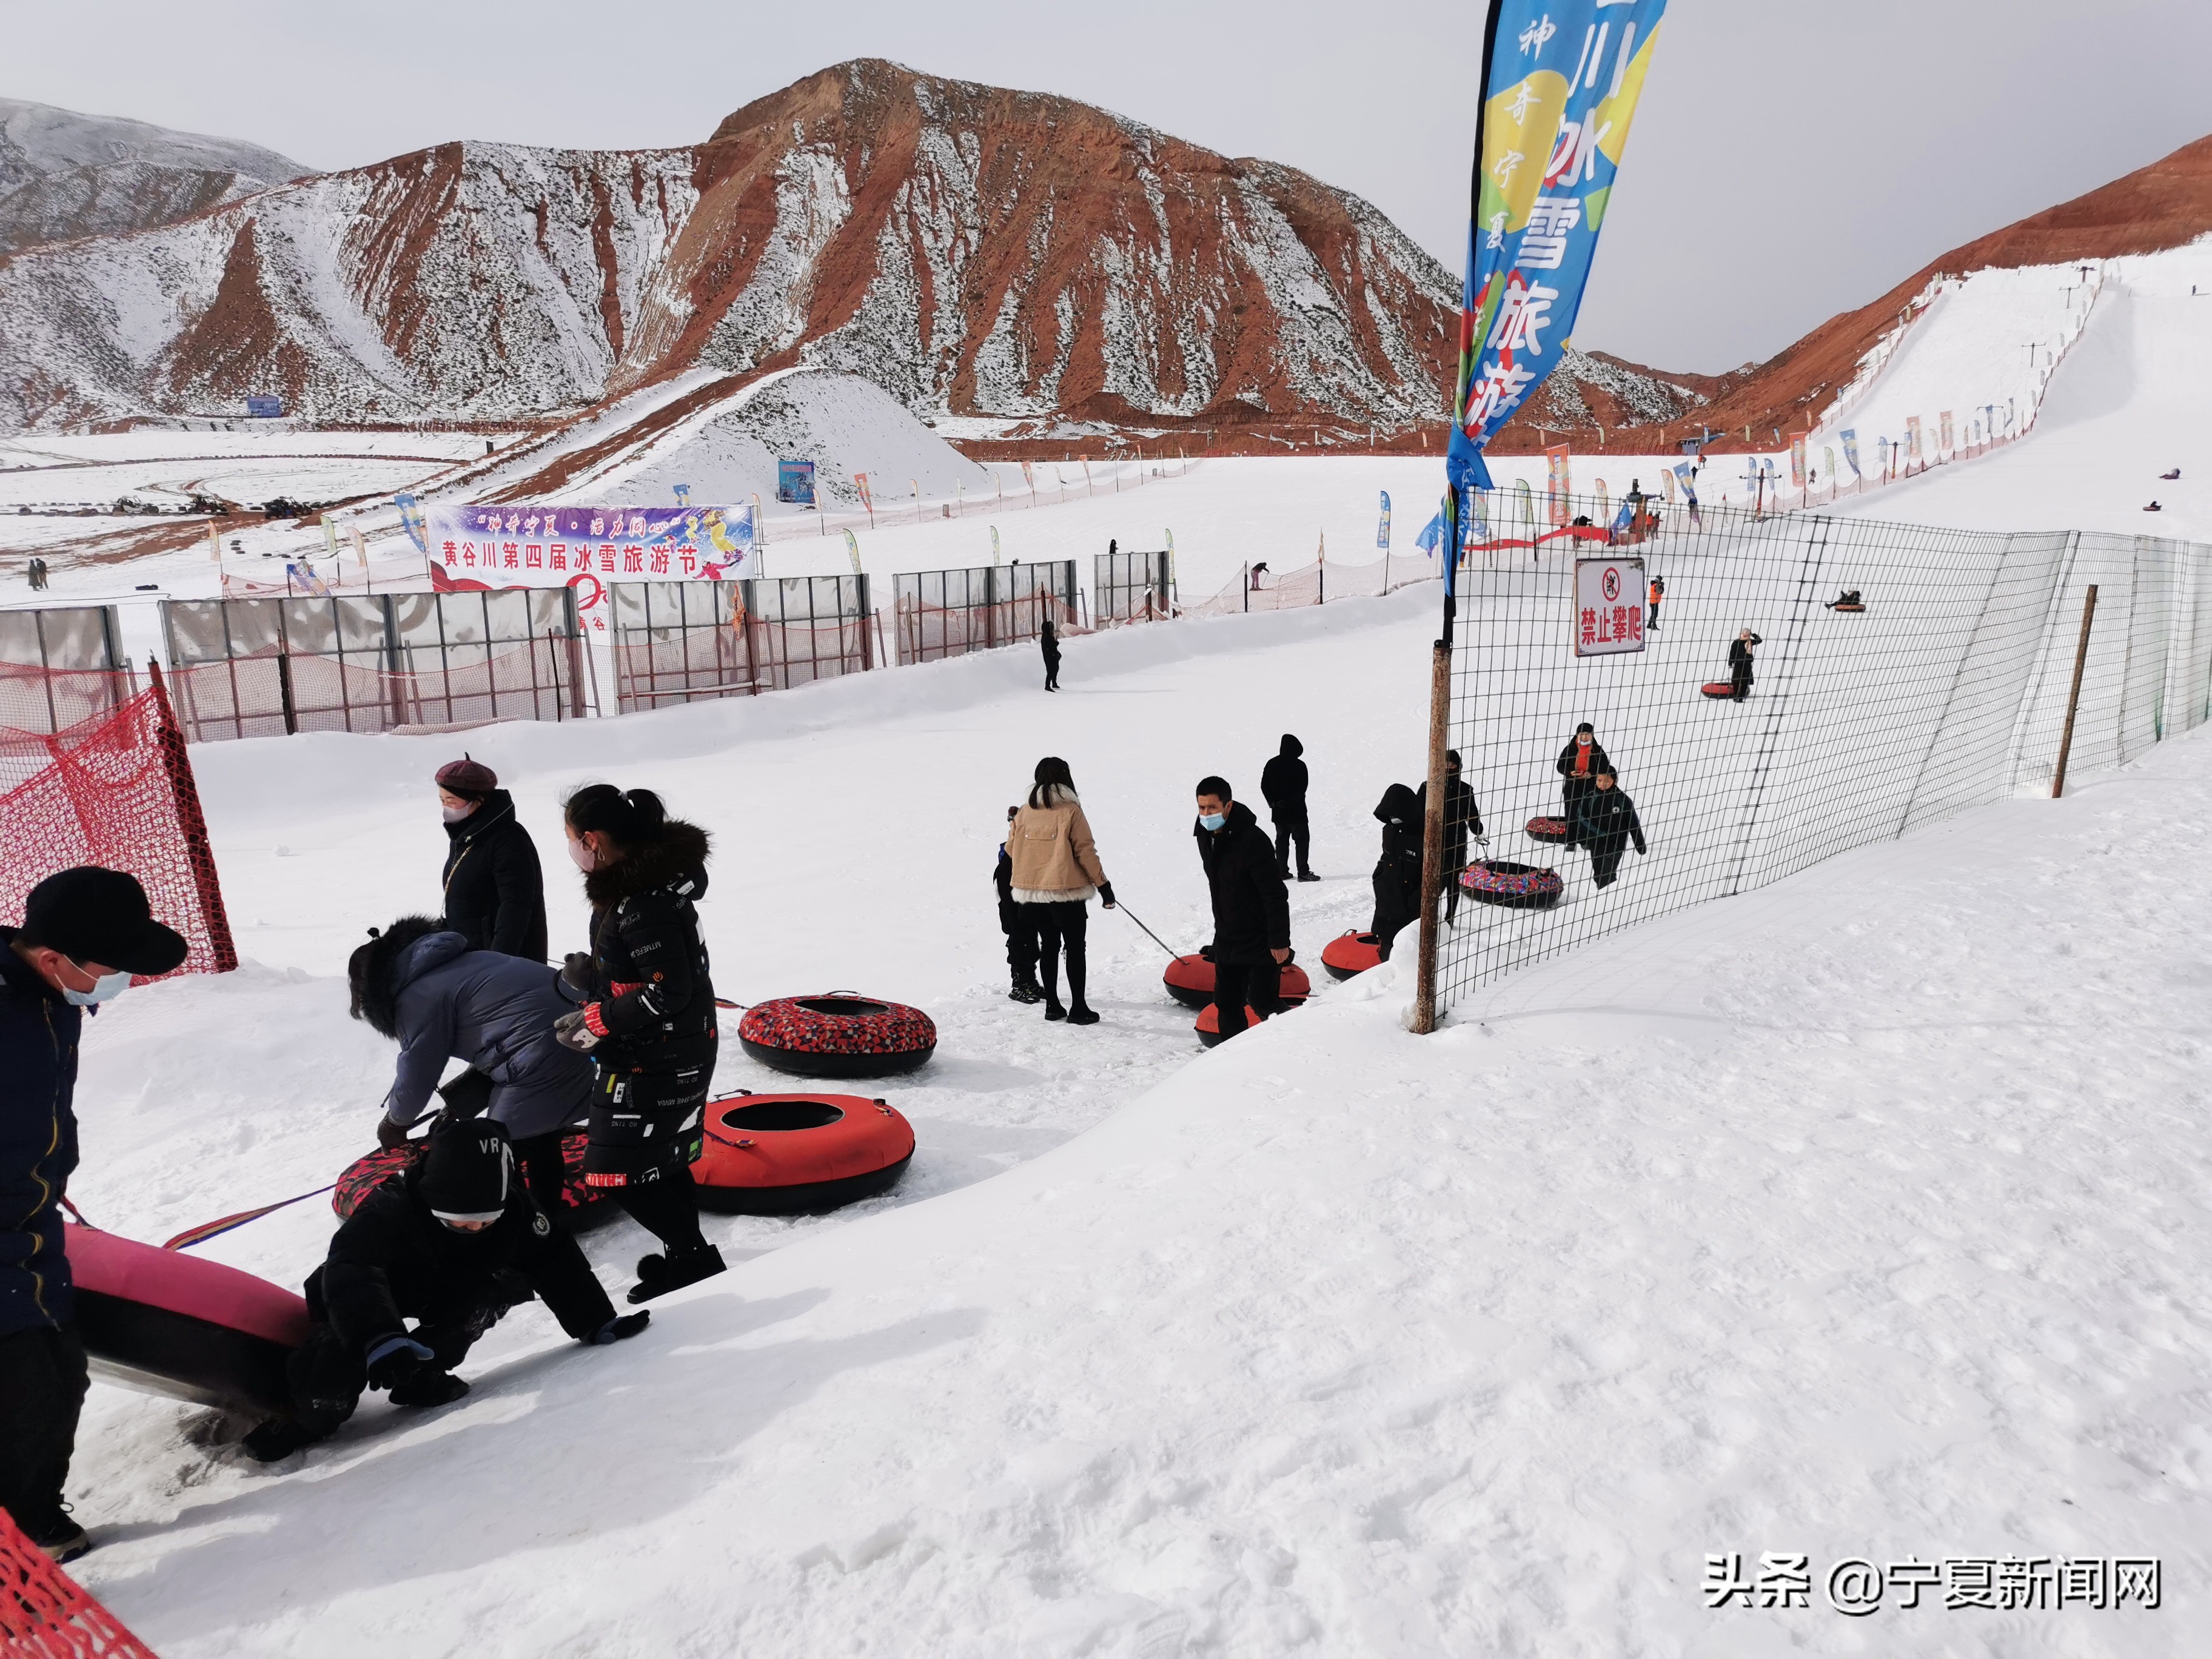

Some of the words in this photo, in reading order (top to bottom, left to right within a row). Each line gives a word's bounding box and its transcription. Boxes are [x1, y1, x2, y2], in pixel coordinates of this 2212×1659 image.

[1463, 0, 1637, 446] 川冰雪旅游
[442, 540, 698, 575] 黄谷川第四届冰雪旅游节
[1581, 605, 1641, 646] 禁止攀爬
[479, 1137, 499, 1154] VR
